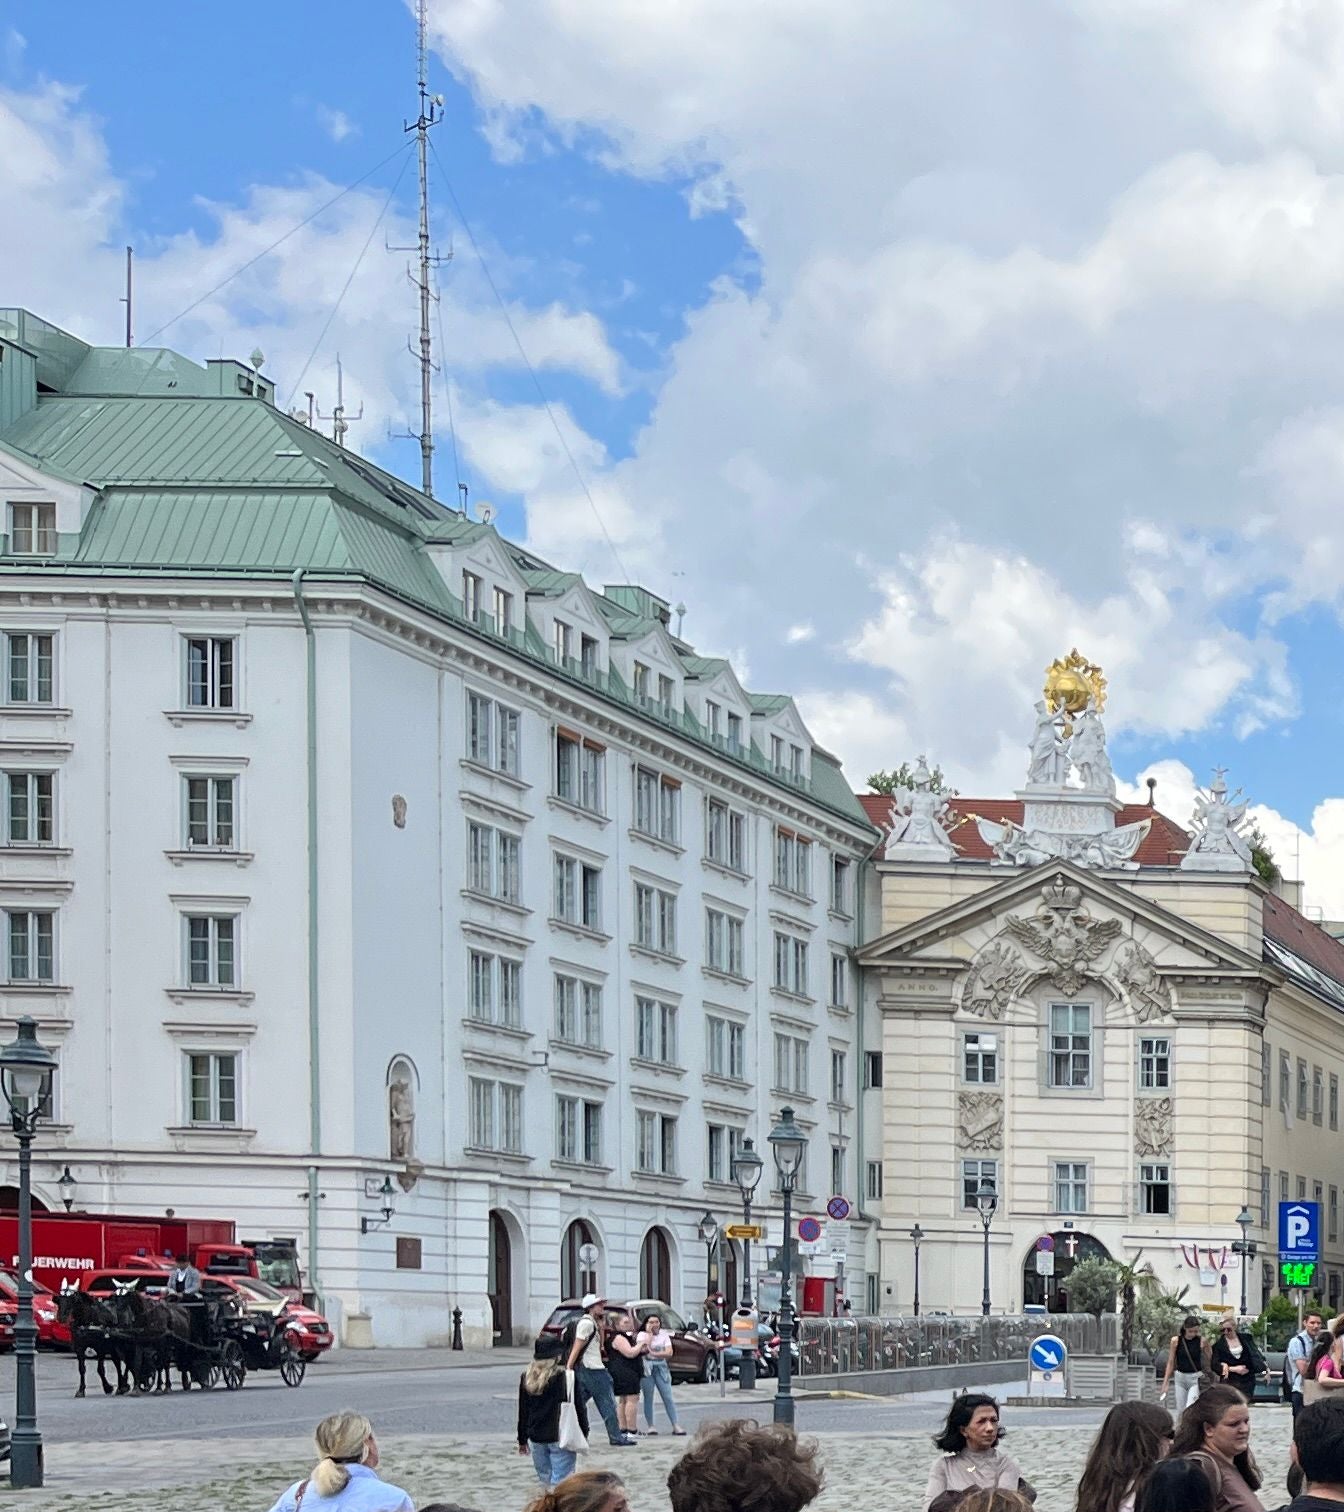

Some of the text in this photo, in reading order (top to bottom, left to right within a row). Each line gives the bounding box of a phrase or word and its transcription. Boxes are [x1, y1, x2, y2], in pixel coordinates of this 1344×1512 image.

[1287, 1215, 1310, 1249] P
[12, 1255, 95, 1270] FUERWEHR
[1286, 1273, 1310, 1286] FREI
